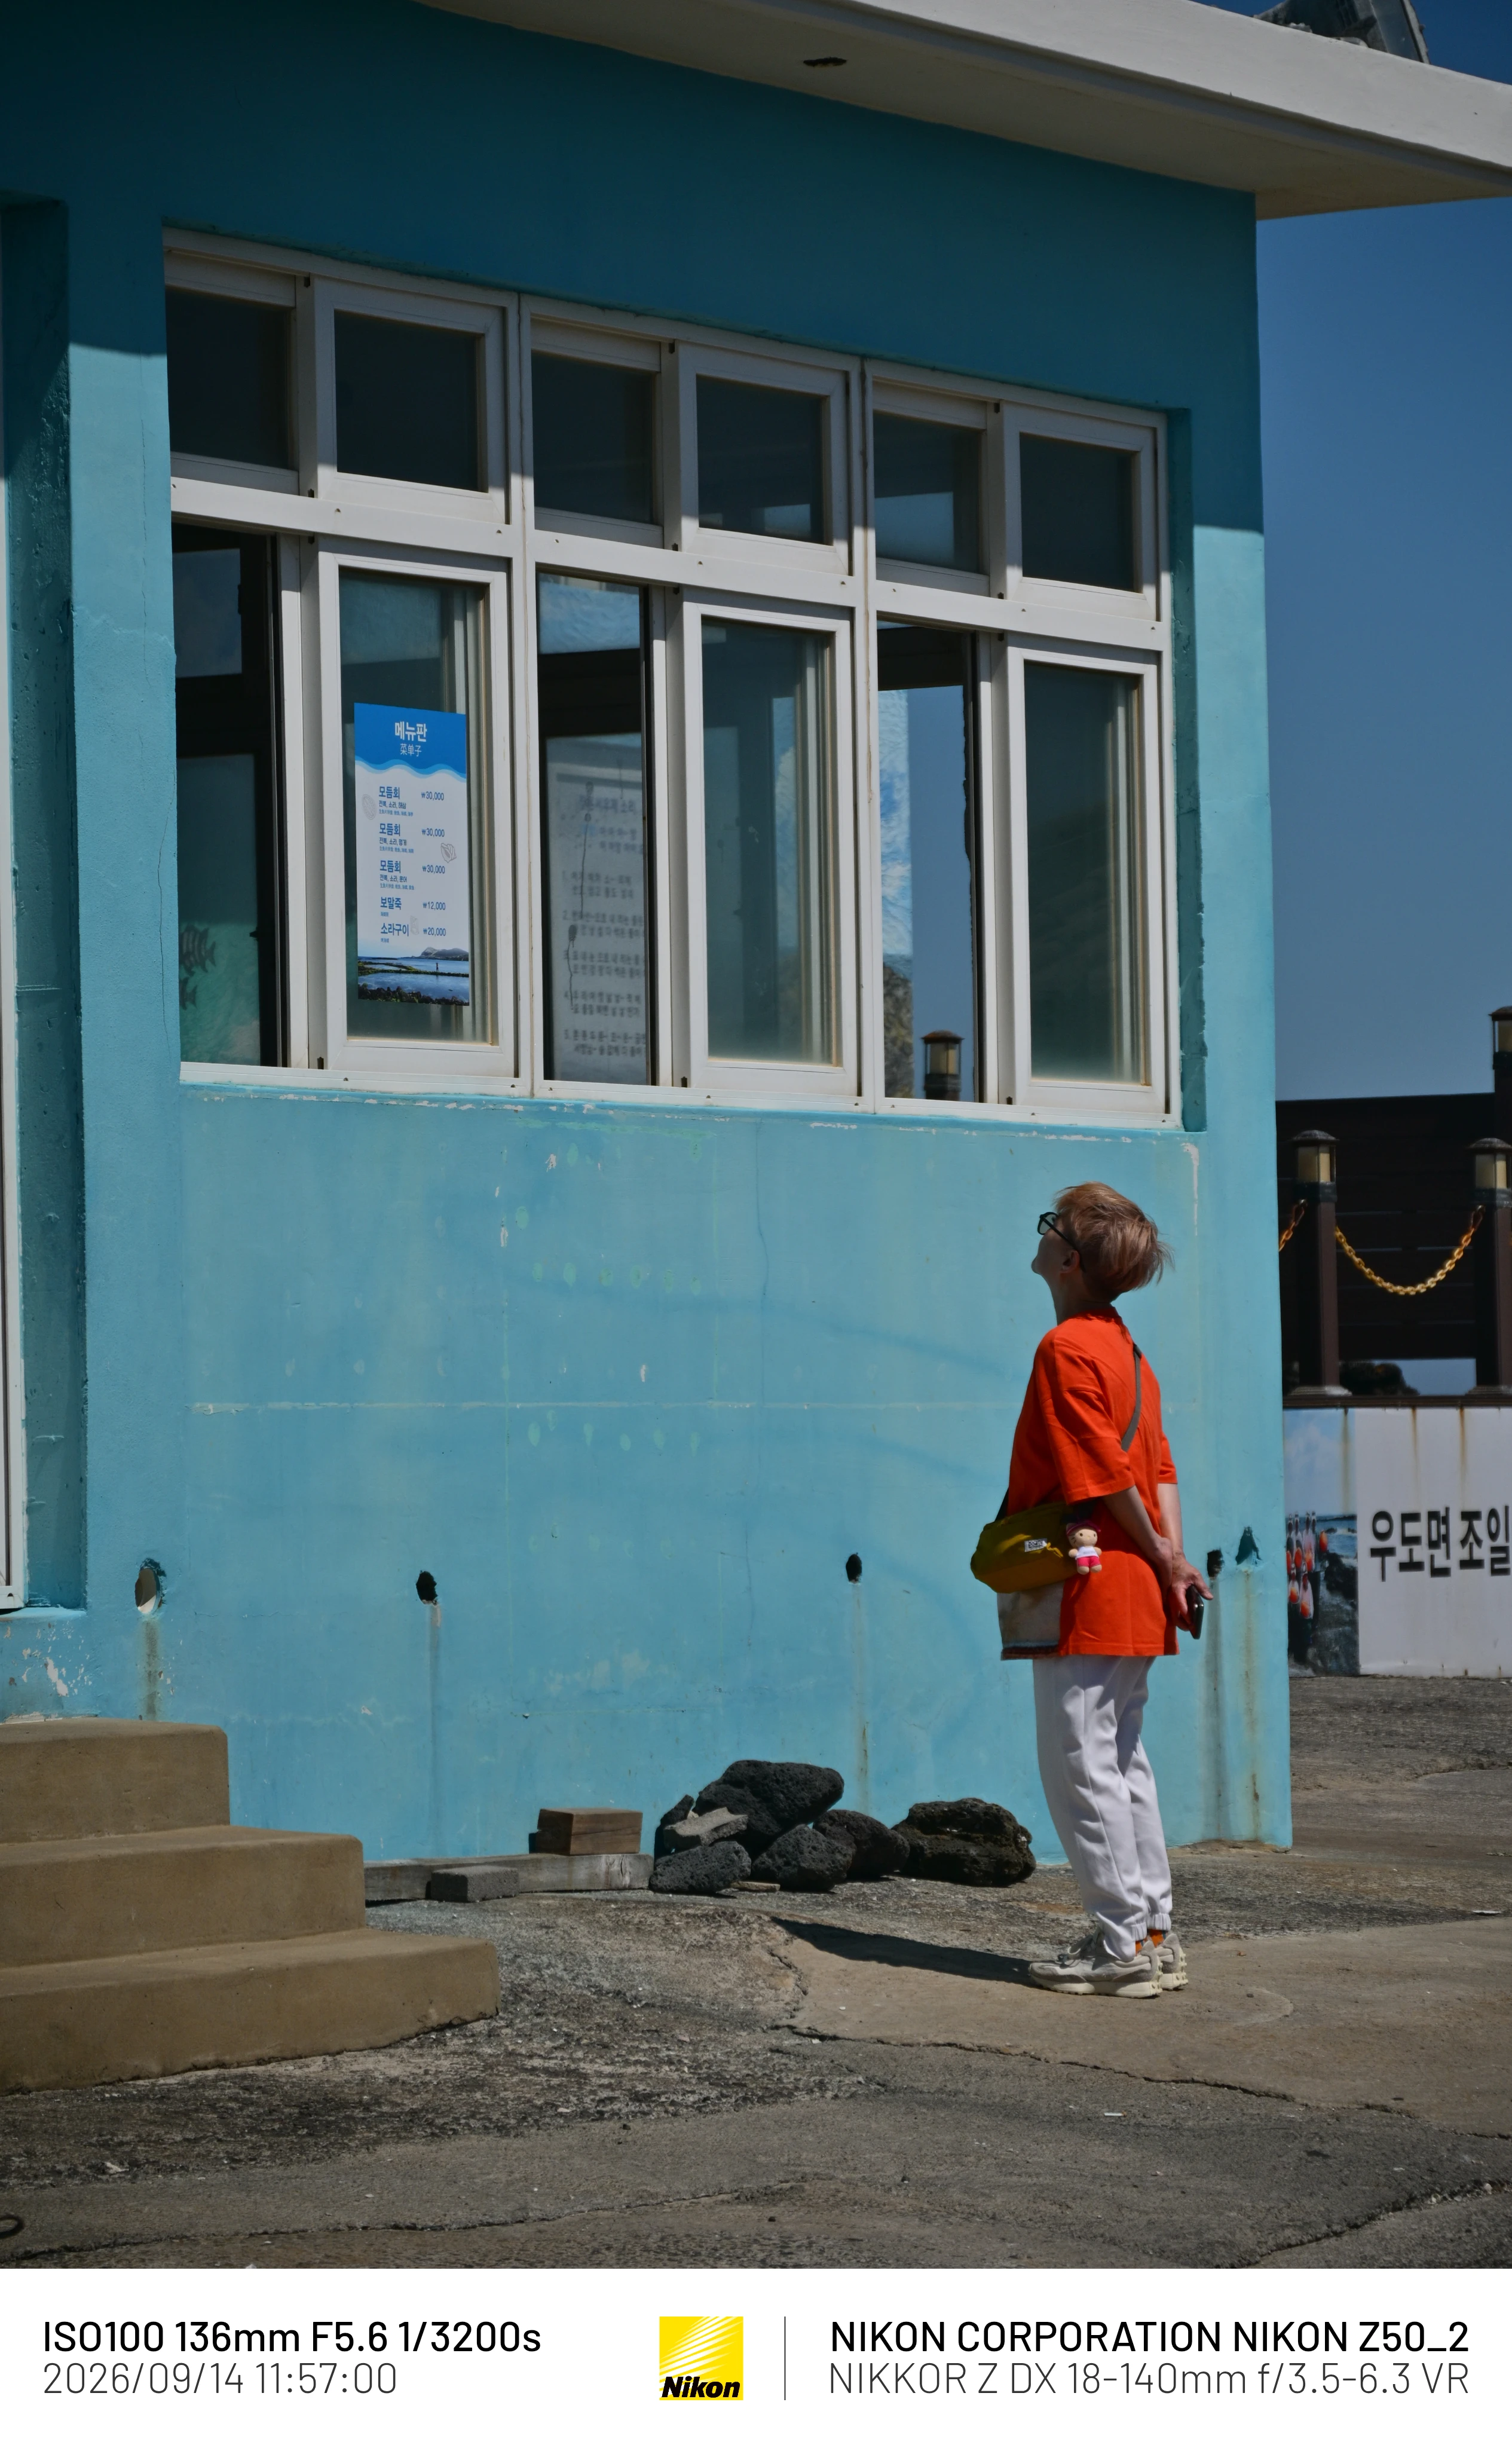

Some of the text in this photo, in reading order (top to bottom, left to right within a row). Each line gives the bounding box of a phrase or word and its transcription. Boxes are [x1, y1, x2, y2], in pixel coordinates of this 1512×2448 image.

[394, 721, 427, 742] 메뉴판
[400, 743, 422, 757] 菜单子
[378, 786, 445, 801] 모듬회 ₩30,000
[379, 823, 445, 837] 모듬회 ₩30,000
[379, 859, 446, 874] 모듬회 ₩30,000
[380, 896, 446, 911] 보말죽 ₩12,000
[380, 922, 446, 937] 소라구이 ₩20,000
[1370, 1504, 1511, 1583] 우도면 조일
